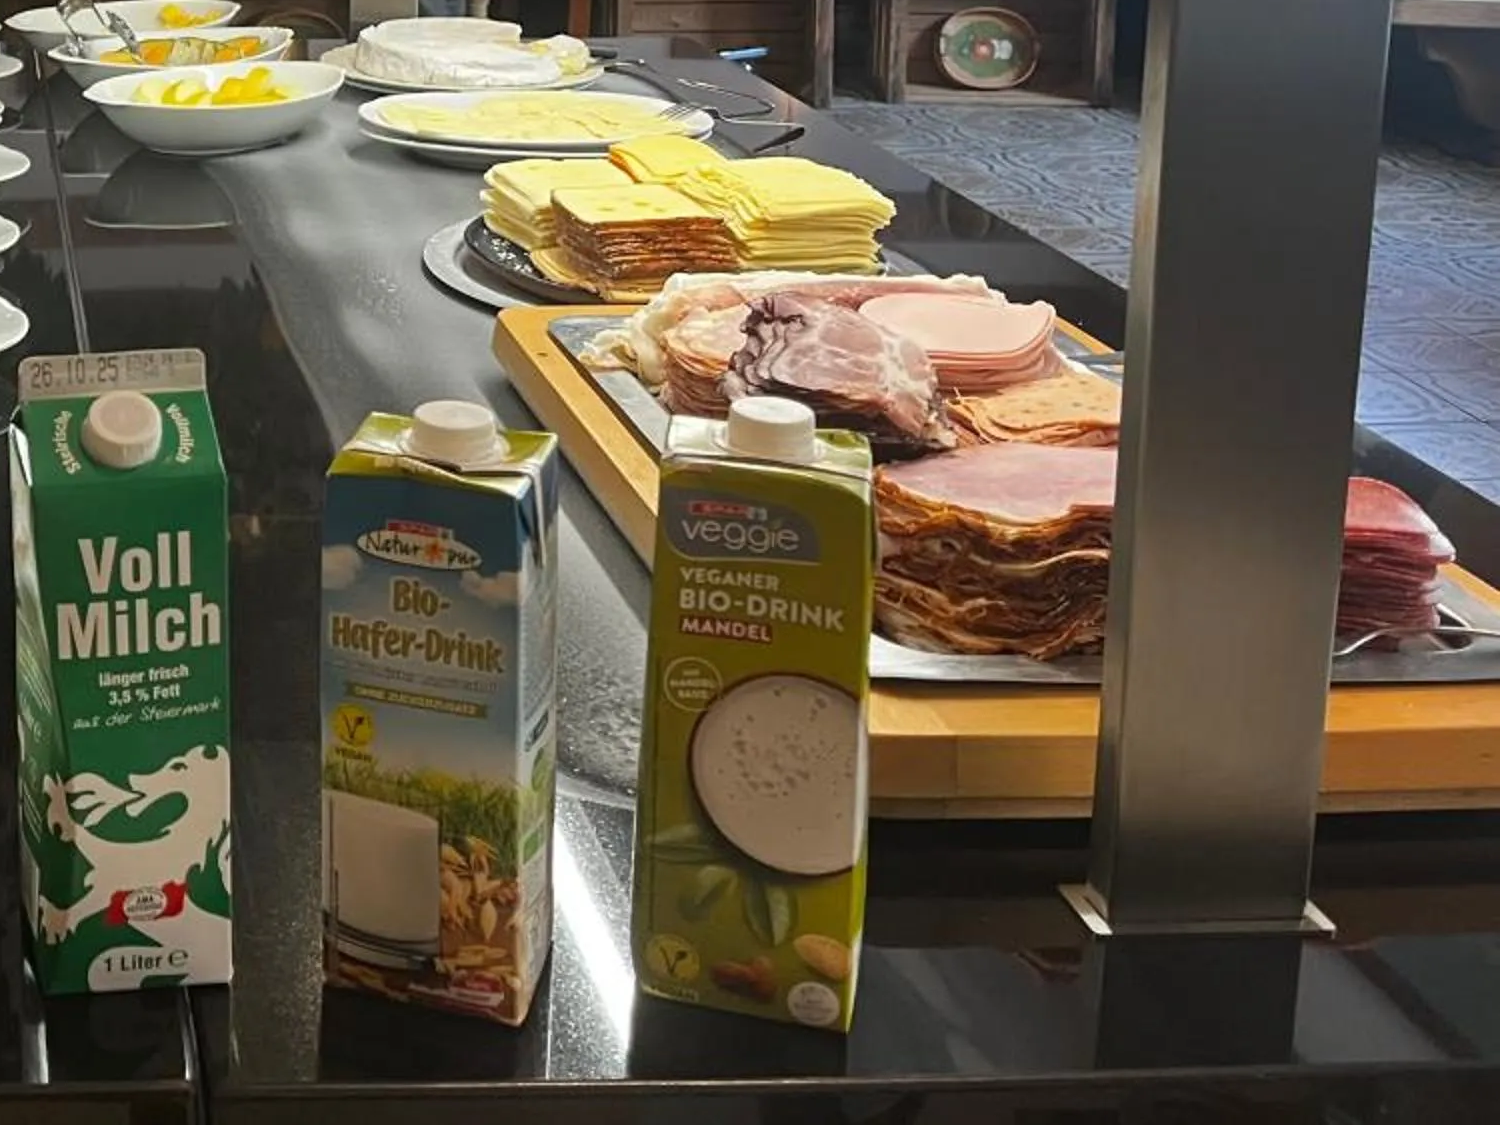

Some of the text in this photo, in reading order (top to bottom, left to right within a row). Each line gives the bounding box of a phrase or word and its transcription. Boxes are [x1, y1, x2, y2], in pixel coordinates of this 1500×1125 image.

[30, 356, 120, 390] 26.10.25
[366, 529, 421, 556] Natur
[681, 519, 800, 554] veggie
[78, 530, 192, 595] Voll
[679, 566, 779, 592] VEGANER
[392, 578, 451, 616] Bio-
[679, 588, 845, 632] BIO-DRINK
[56, 591, 222, 660] Milch
[681, 618, 772, 642] MANDEL
[330, 615, 504, 674] Hafer-Drink
[98, 664, 189, 687] länger frisch
[108, 690, 131, 707] 3,5
[153, 683, 181, 700] Fett
[104, 956, 113, 973] 1
[121, 953, 163, 972] Liter
